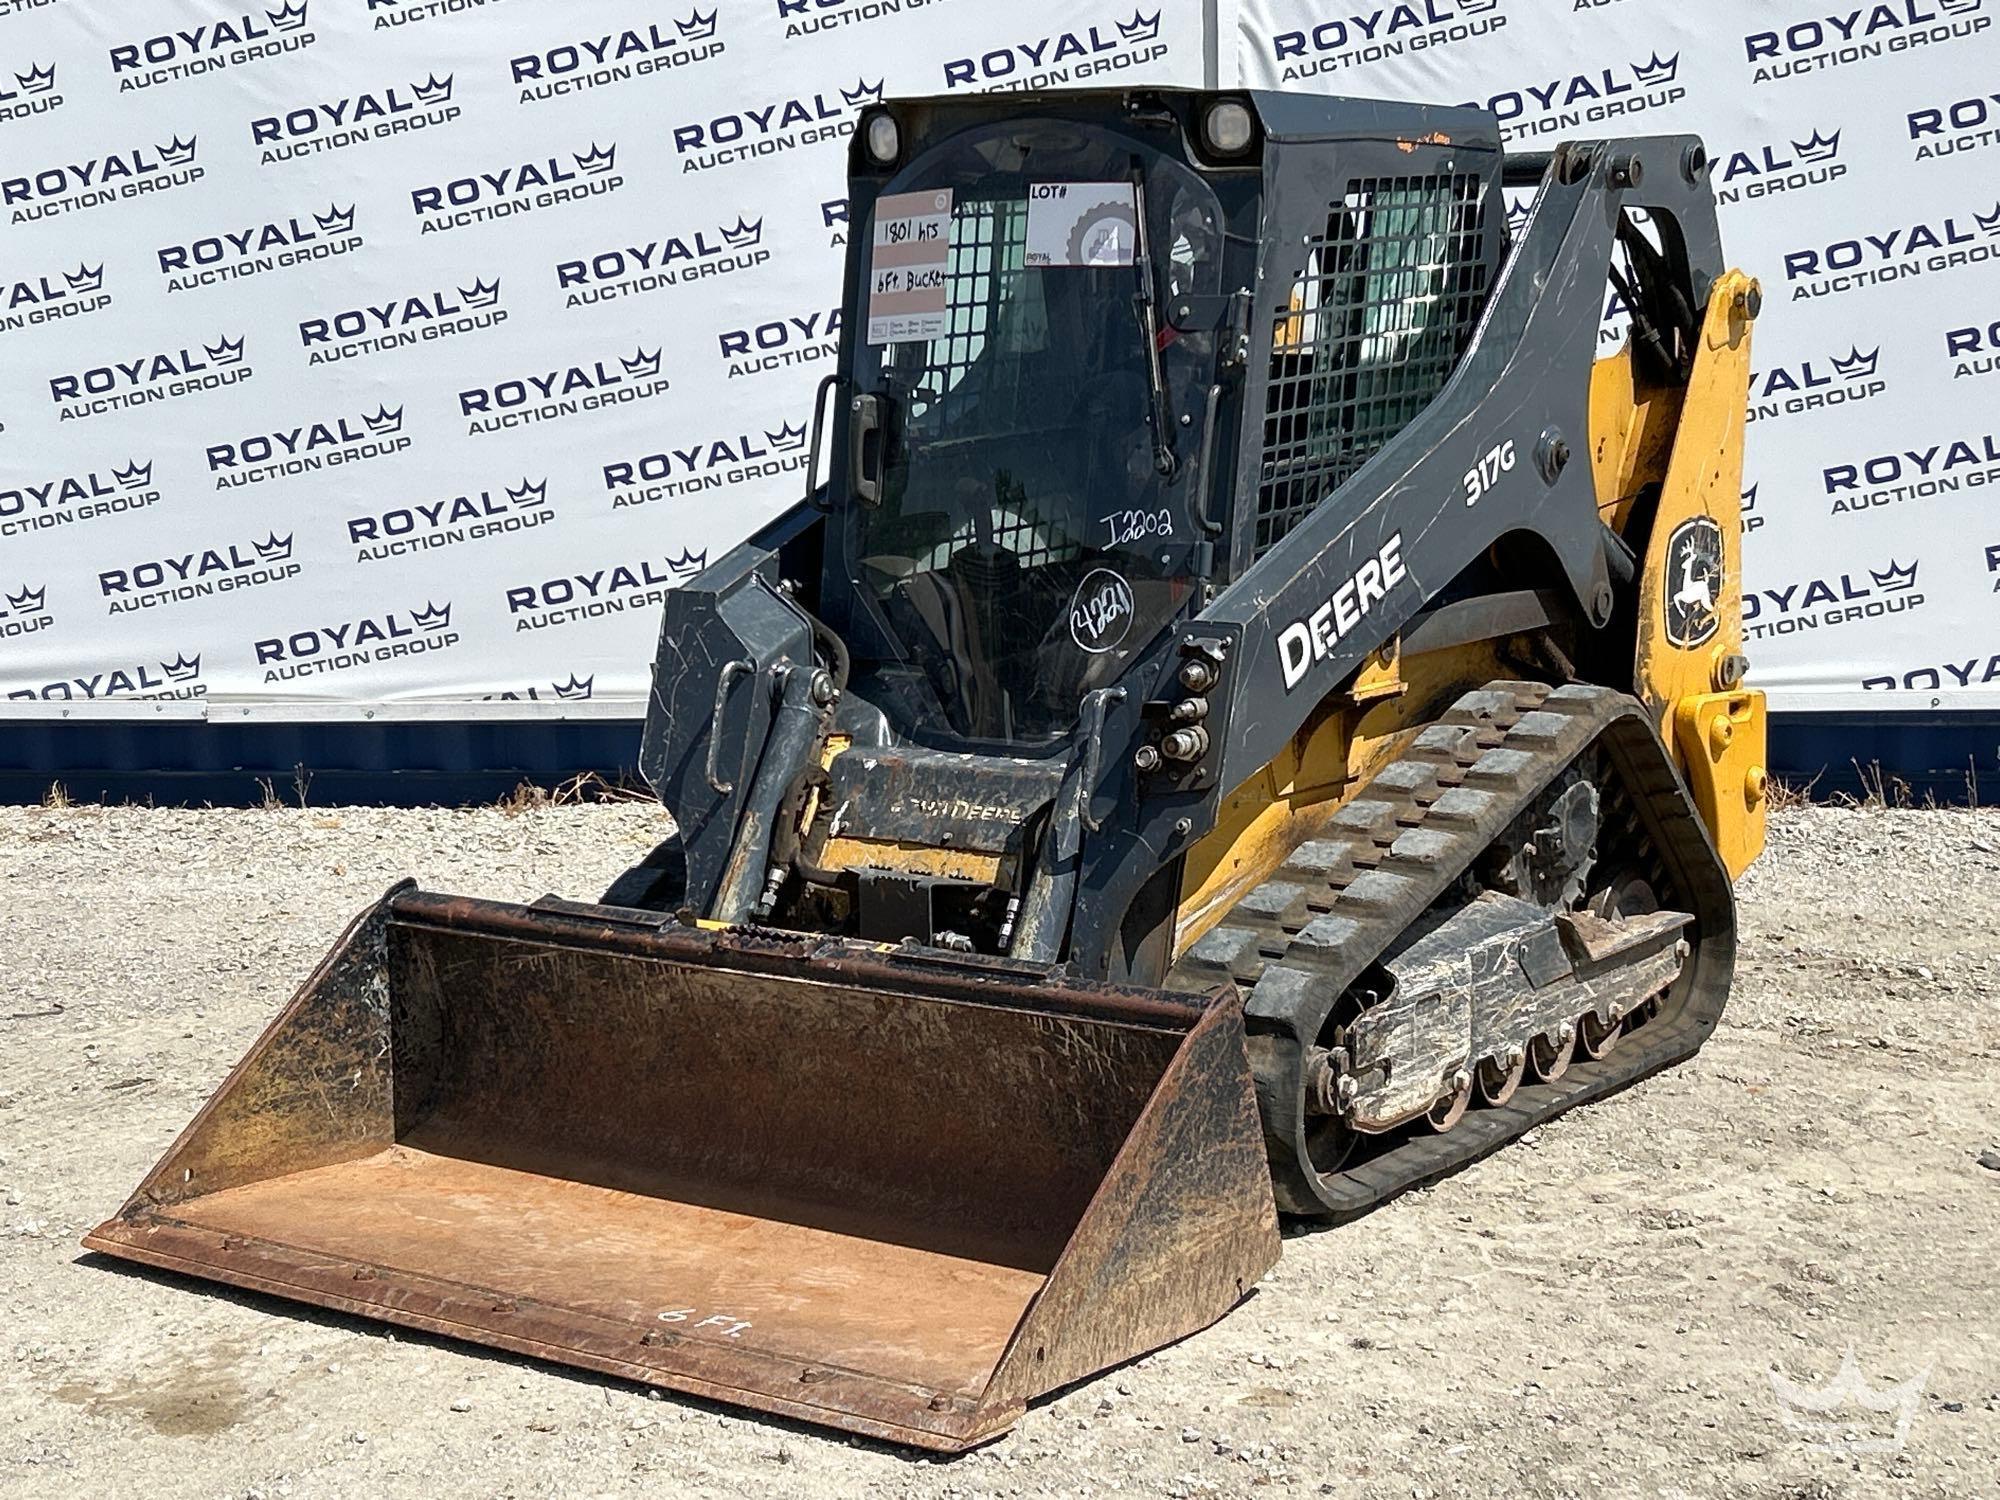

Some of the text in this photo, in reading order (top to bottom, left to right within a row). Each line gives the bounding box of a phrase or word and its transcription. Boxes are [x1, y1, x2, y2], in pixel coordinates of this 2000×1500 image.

[108, 14, 270, 74] ROYAL
[785, 0, 902, 40] AUCTION
[1272, 0, 1455, 62] ROYAL
[1743, 0, 1937, 64] ROYAL
[119, 32, 316, 94] AUCTION GROUP
[509, 23, 678, 85] ROYAL
[519, 41, 726, 105] AUCTION GROUP
[943, 26, 1118, 89] ROYAL
[1074, 43, 1169, 79] GROUP
[1281, 15, 1508, 83] AUCTION GROUP
[1752, 15, 1992, 85] AUCTION GROUP
[0, 94, 64, 122] ROUP
[250, 87, 414, 146] ROYAL
[1457, 68, 1633, 121] OYAL
[1500, 86, 1686, 143] CTION GROUP
[260, 106, 462, 166] AUCTION GROUP
[672, 93, 843, 154] ROYAL
[682, 121, 858, 175] AUCTION GRO
[1914, 128, 2000, 162] AUCTI
[0, 149, 160, 206] ROYAL
[11, 166, 206, 226] AUCTION GROUP
[410, 157, 577, 216] ROYAL
[420, 175, 624, 236] AUCTION GROUP
[1031, 184, 1068, 200] LOT#
[1745, 163, 1848, 199] GROUP
[156, 218, 317, 275] ROYAL
[884, 218, 912, 244] 1801
[1783, 218, 1976, 281] ROYAL
[167, 236, 364, 294] AUCTION GROUP
[555, 231, 723, 290] ROYAL
[565, 249, 771, 310] AUCTION GROUP
[1791, 260, 1922, 302] AUCTION
[28, 294, 112, 325] GROUP
[298, 291, 462, 348] ROYAL
[308, 309, 509, 367] AUCTION GROUP
[48, 348, 208, 403] ROYAL
[59, 366, 253, 423] AUCTION GROUP
[458, 361, 623, 417] ROYAL
[1784, 380, 1886, 414] GROUP
[468, 379, 670, 437] AUCTION GROUP
[205, 417, 366, 472] ROYAL
[215, 436, 412, 491] AUCTION GROUP
[602, 434, 768, 491] ROYAL
[1822, 434, 2000, 495] ROYAL
[0, 472, 116, 517] OYAL
[612, 473, 723, 510] AUCTION
[1463, 439, 1517, 508] 317G
[1830, 475, 1960, 516] AUCTION
[0, 490, 161, 537] CTION GROUP
[346, 491, 509, 545] ROYAL
[357, 509, 556, 564] AUCTION GROUP
[97, 544, 256, 597] ROYAL
[108, 563, 302, 616] AUCTION GROUP
[505, 561, 669, 614] ROYAL
[1741, 574, 1871, 622] OYAL
[0, 615, 54, 639] OUP
[515, 597, 625, 633] AUCTION
[1070, 581, 1132, 639] 4221
[1277, 533, 1408, 691] DEERE
[1823, 593, 1925, 626] GROUP
[253, 613, 414, 666] ROYAL
[263, 632, 460, 684] AUCTION GROUP
[657, 1308, 697, 1322] 6
